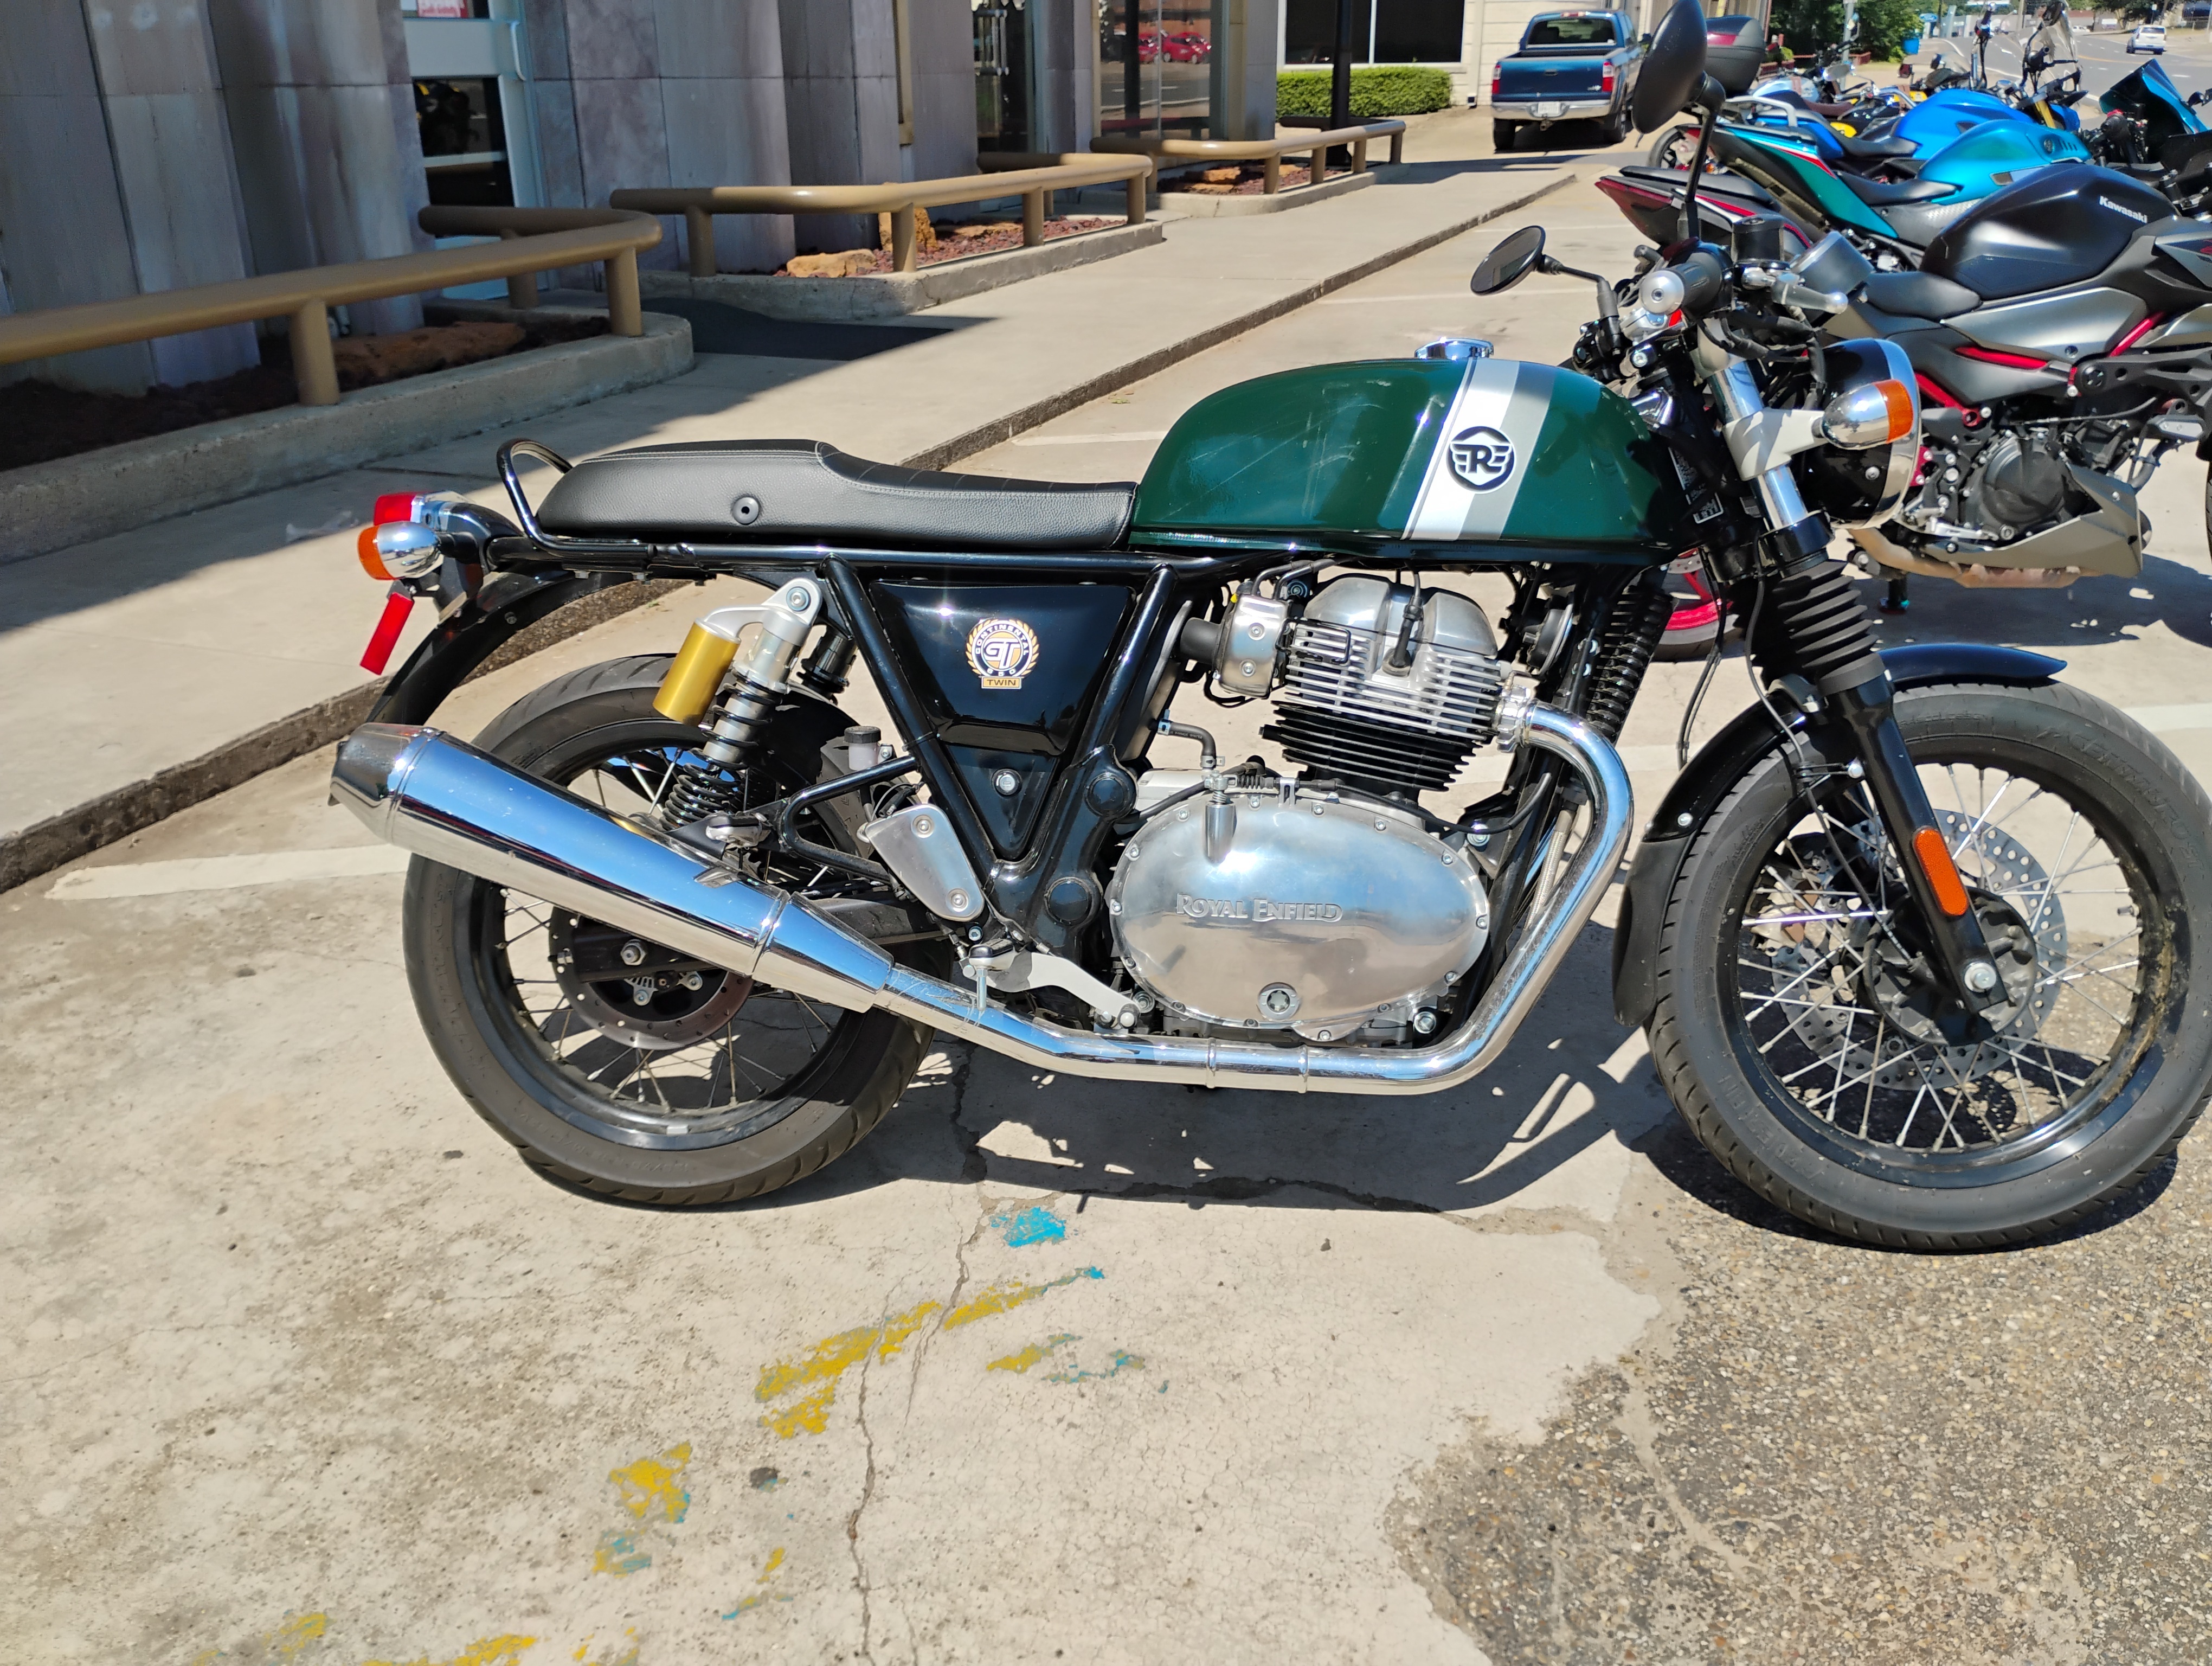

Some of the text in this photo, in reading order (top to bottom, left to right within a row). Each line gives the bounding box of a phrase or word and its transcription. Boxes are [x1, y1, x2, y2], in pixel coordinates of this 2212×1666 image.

[2099, 195, 2147, 223] Kawasaki
[975, 624, 1029, 656] CONTINENTAL
[983, 638, 1020, 669] GT
[987, 668, 1017, 676] 650
[1176, 893, 1343, 922] ROYAL ENFIELD
